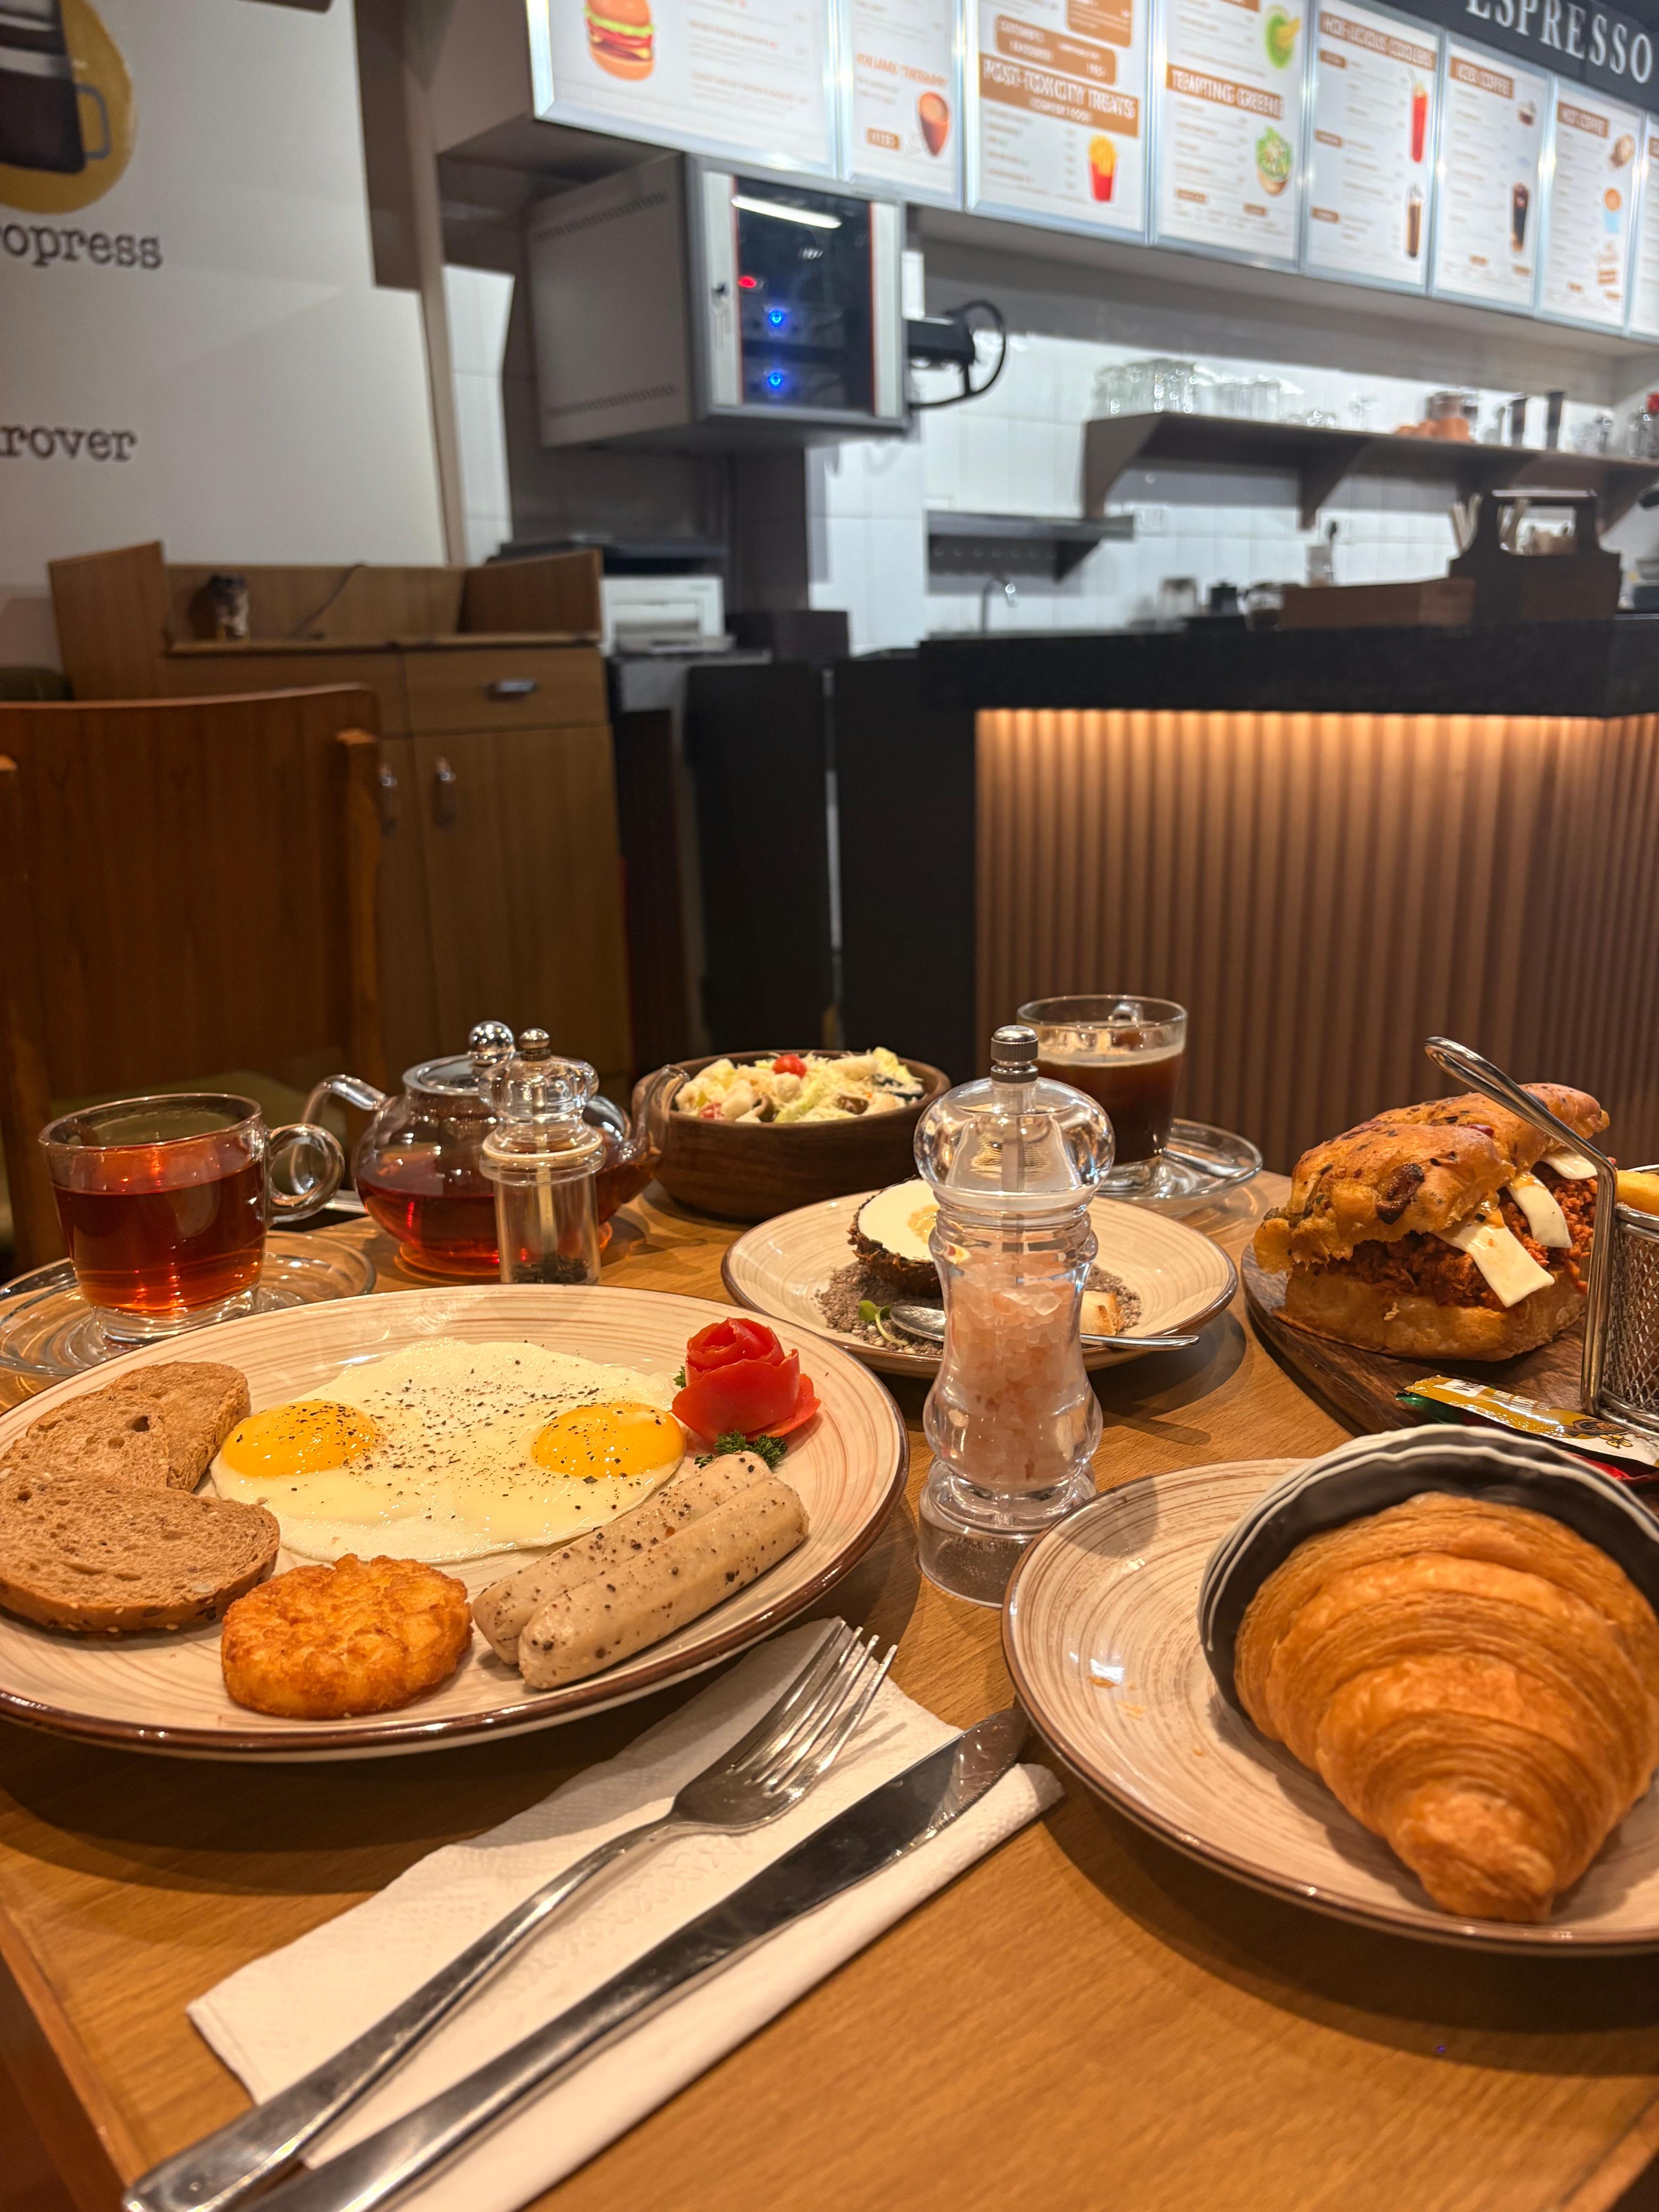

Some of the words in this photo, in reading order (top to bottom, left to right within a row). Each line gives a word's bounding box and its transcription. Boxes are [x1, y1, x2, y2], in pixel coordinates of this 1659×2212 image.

[1171, 69, 1235, 104] TEMPTING
[1088, 89, 1136, 120] TREATS
[0, 223, 163, 269] opress
